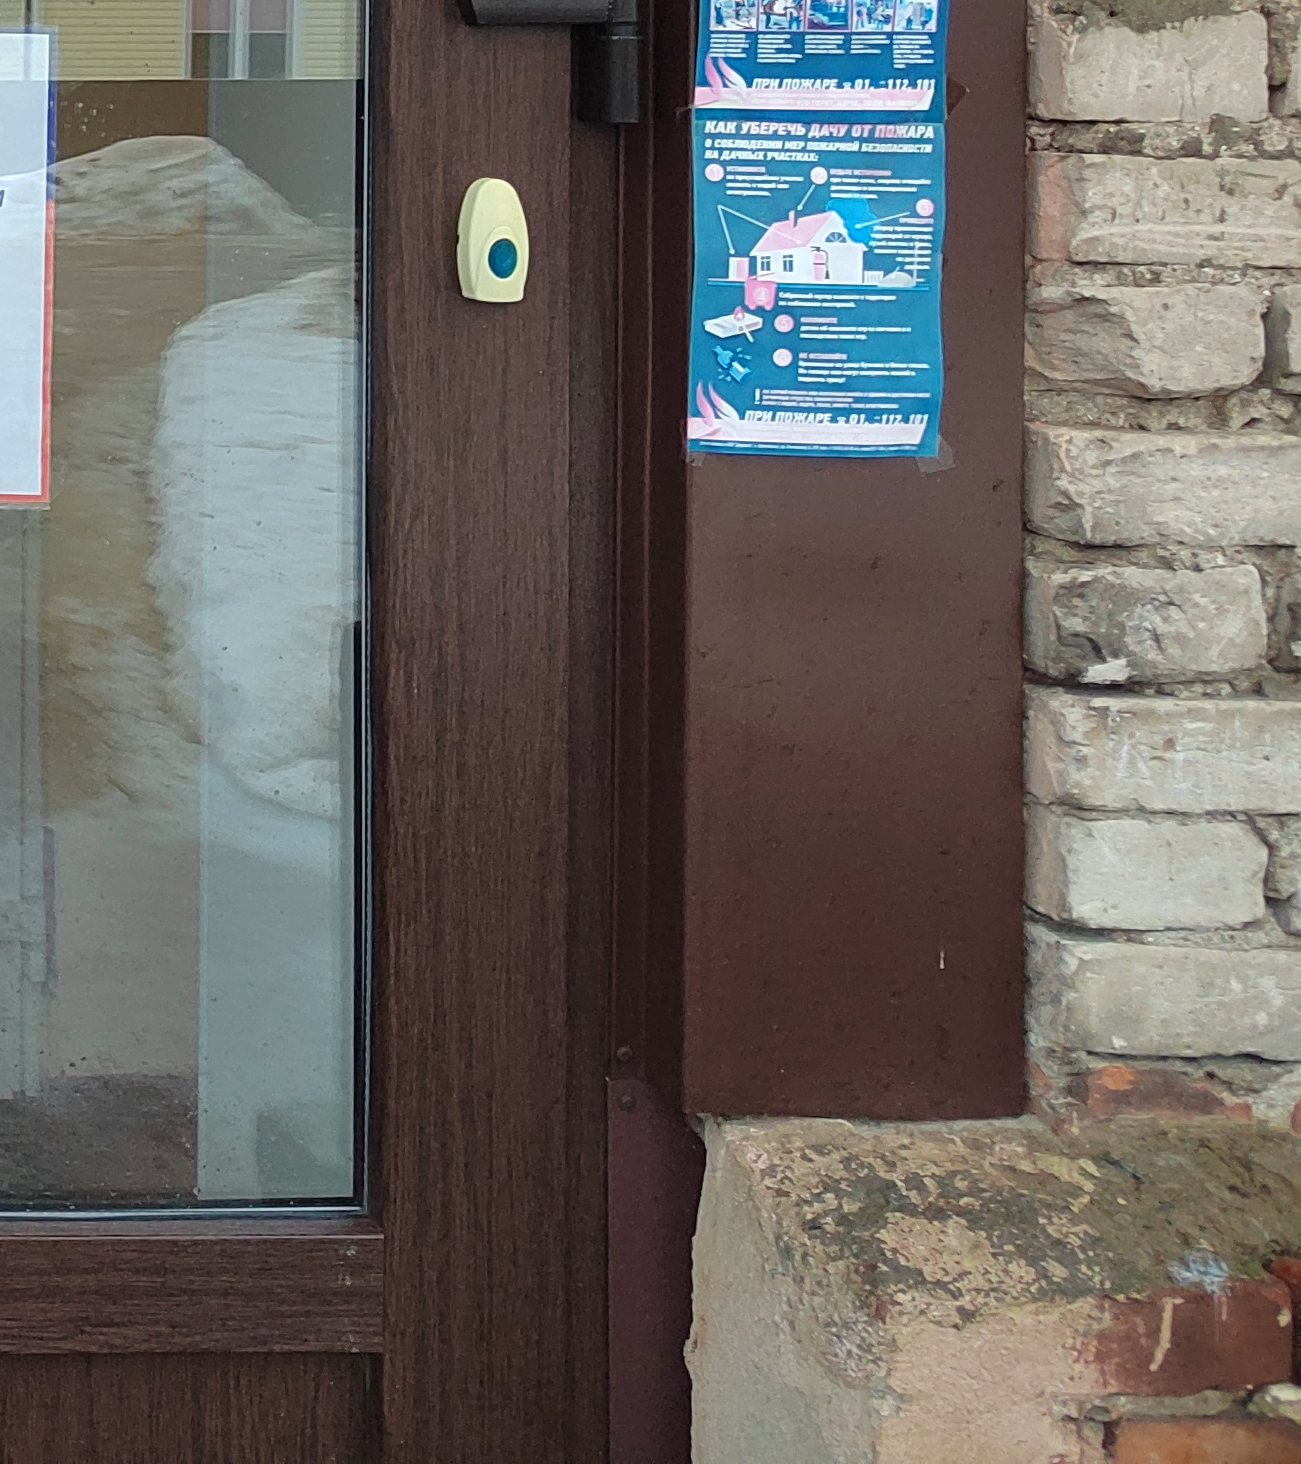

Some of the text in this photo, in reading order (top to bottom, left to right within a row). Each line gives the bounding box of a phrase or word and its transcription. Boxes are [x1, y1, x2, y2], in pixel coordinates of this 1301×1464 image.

[752, 78, 781, 90] ПРИ
[782, 78, 837, 91] ПОЖАРЕ
[704, 120, 935, 139] КАК УБЕРЕЧЬ ДАЧУ ОТ ПОЖАРА
[745, 410, 773, 423] ПРИ
[774, 412, 832, 424] ПОЖАРЕ
